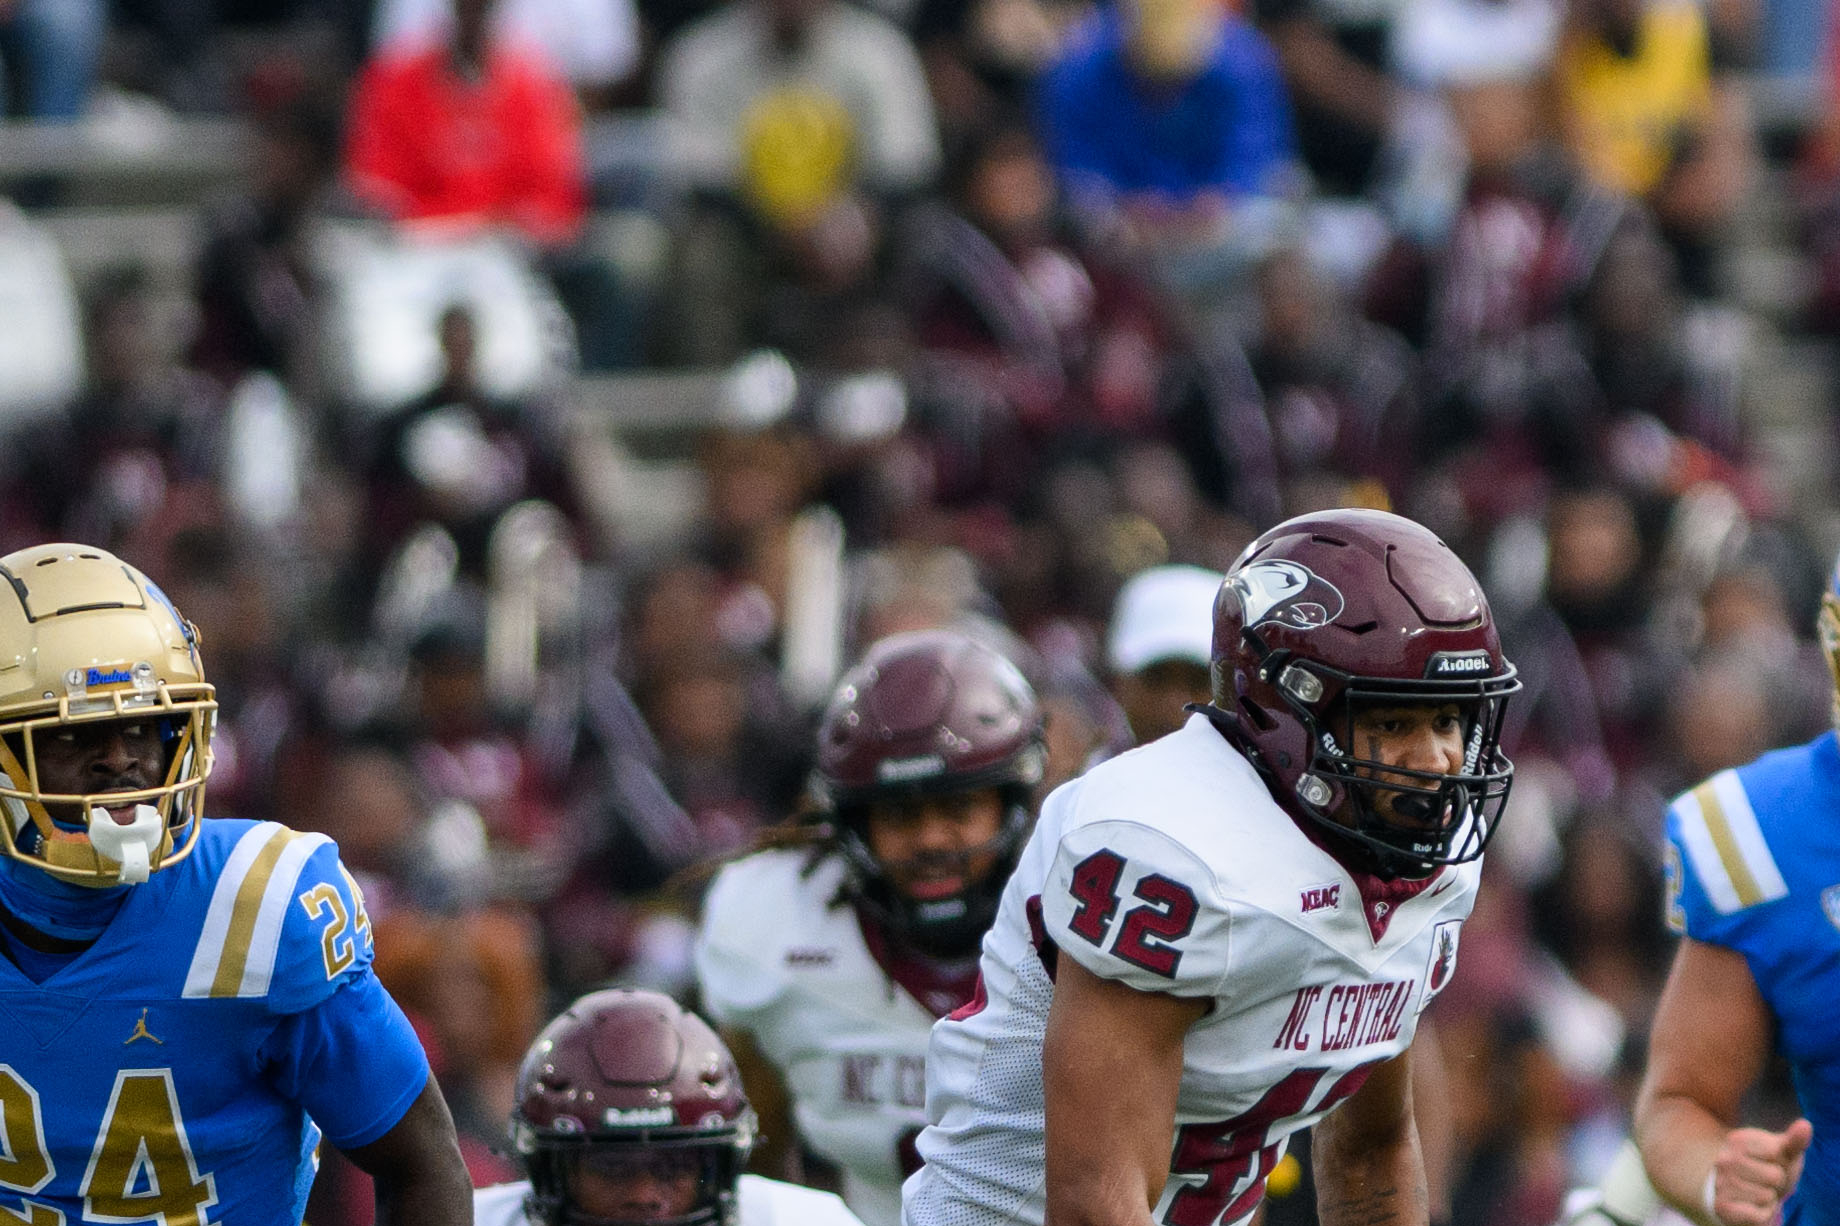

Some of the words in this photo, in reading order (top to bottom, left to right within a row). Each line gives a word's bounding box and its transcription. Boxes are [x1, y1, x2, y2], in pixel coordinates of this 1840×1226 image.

[1460, 723, 1483, 776] Riddell
[1069, 846, 1199, 979] 42
[1301, 884, 1341, 913] MEAC
[1273, 986, 1322, 1051] NC
[1319, 978, 1415, 1052] CENTRAL
